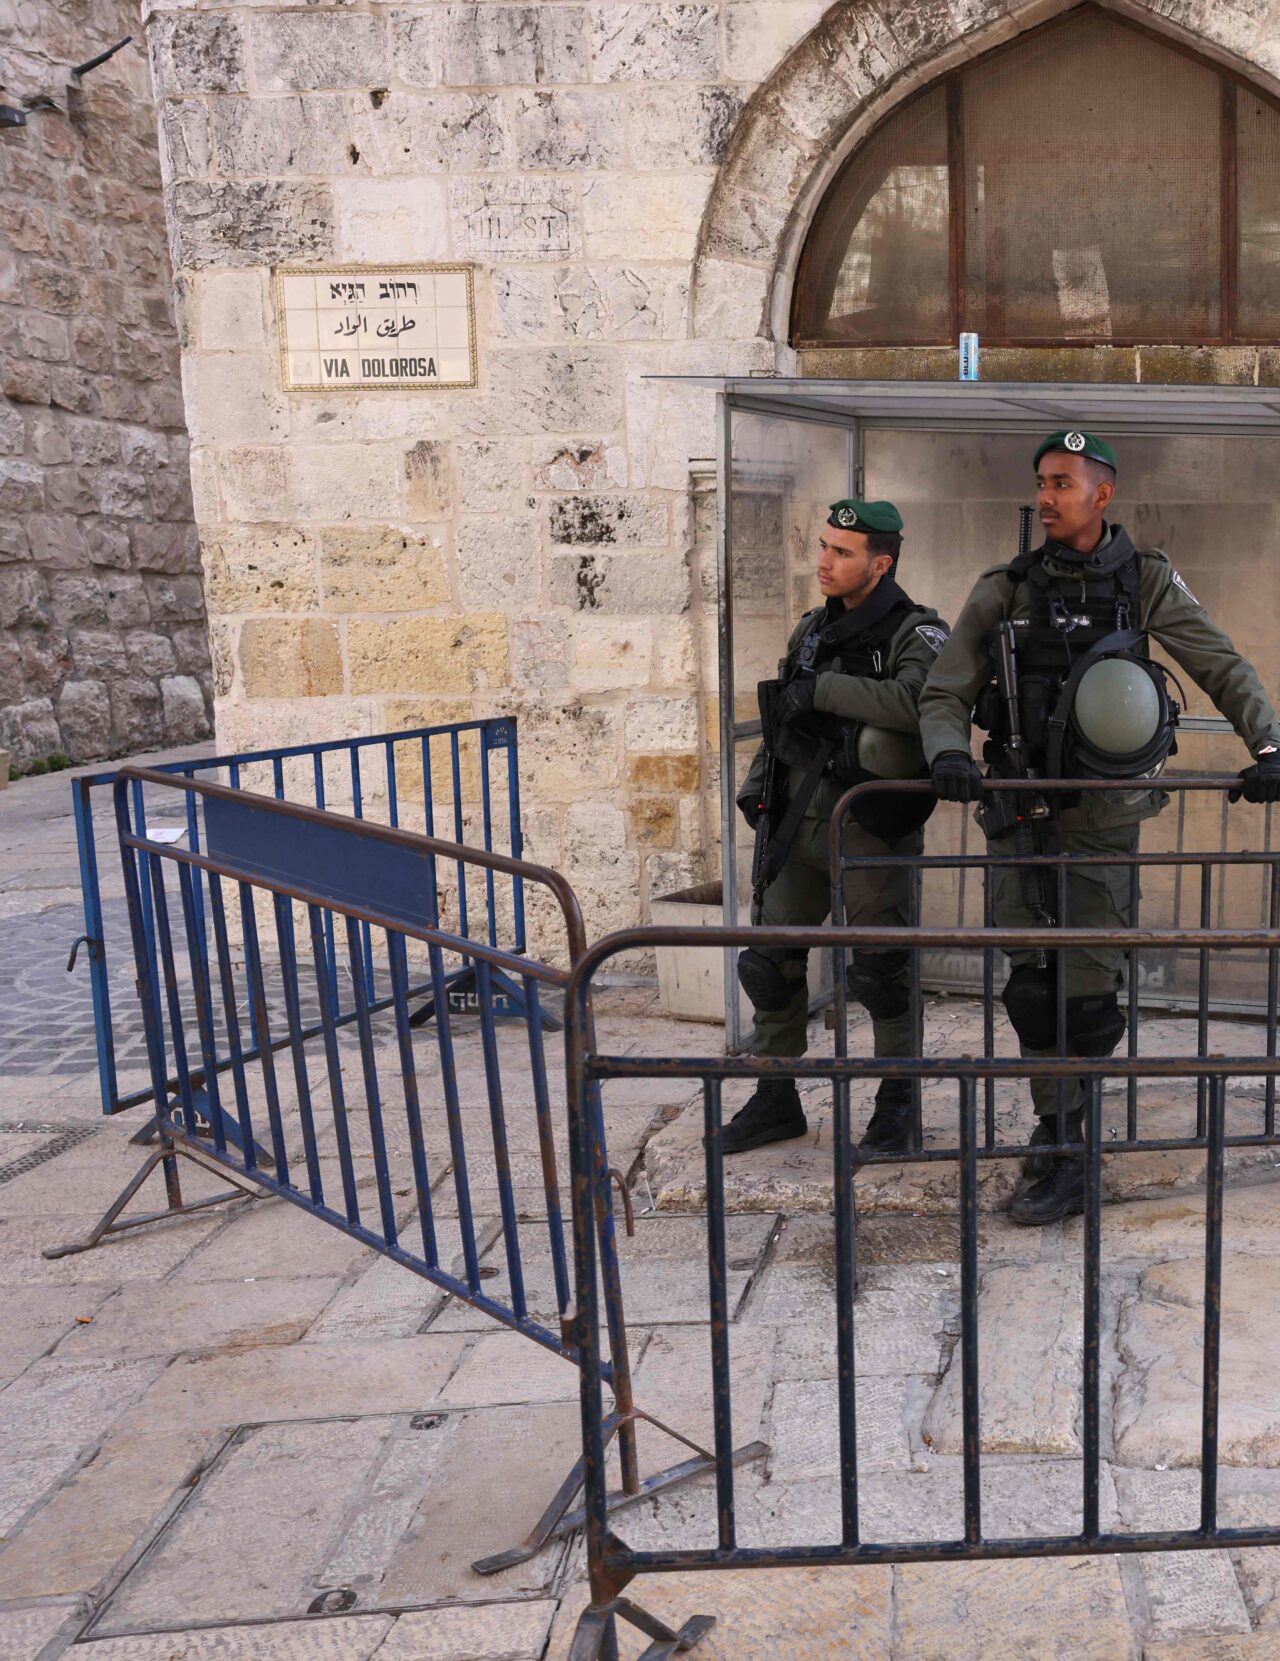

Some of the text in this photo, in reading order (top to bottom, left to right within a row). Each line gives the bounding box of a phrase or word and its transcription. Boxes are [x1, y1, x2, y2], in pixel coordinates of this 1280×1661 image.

[334, 314, 416, 337] طريق الواد
[323, 357, 437, 378] VIA DOLOROSA
